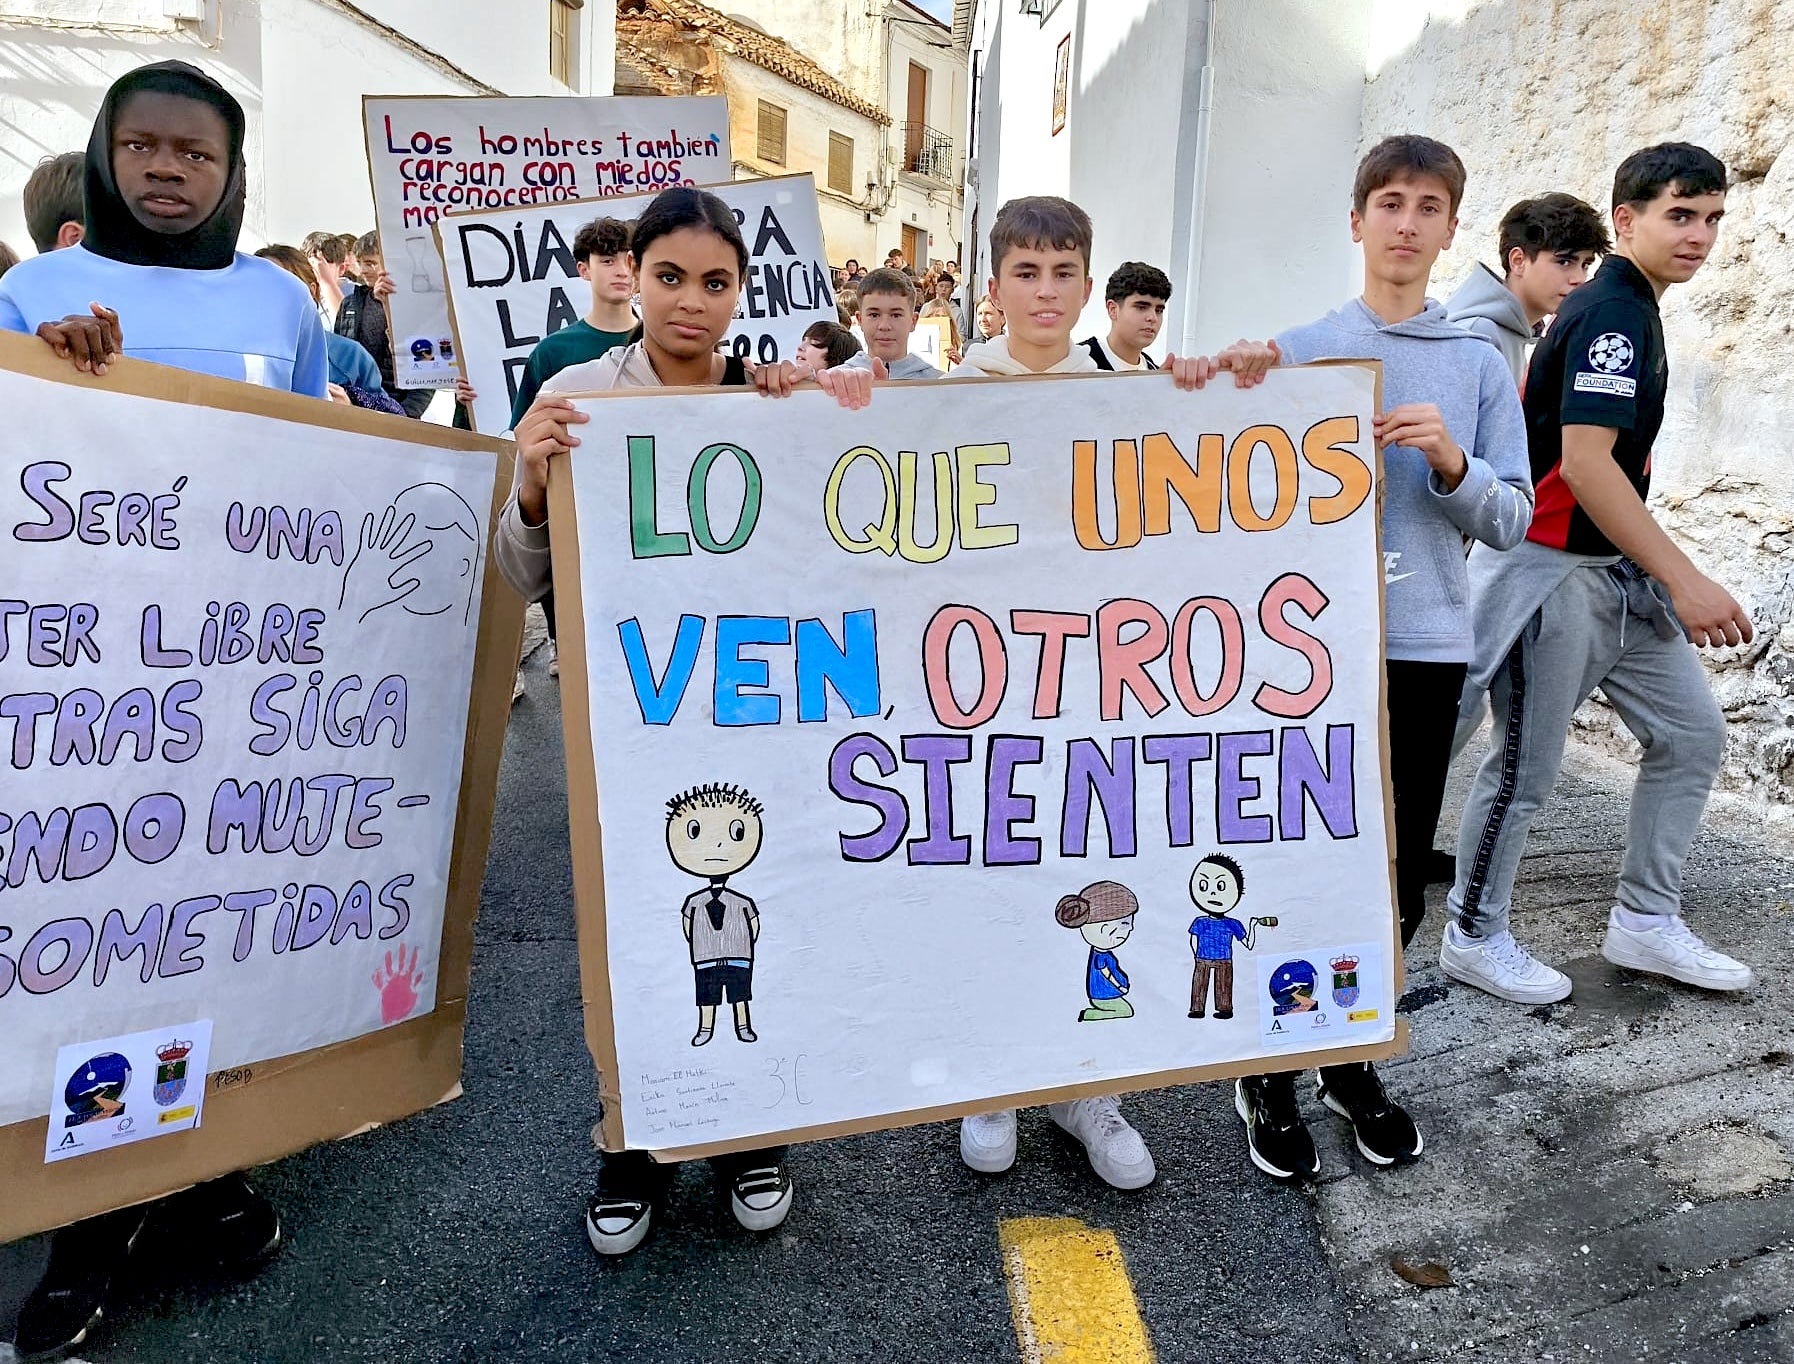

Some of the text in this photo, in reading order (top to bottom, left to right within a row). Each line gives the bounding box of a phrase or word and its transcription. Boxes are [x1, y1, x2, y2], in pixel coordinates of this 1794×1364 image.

[384, 115, 453, 155] Los
[479, 125, 603, 157] hombres
[400, 158, 681, 187] cargan con miedos
[403, 181, 581, 209] reconocerlos
[458, 219, 581, 289] DÍA
[495, 286, 579, 349] LA
[1576, 378, 1636, 392] FOUNDATION
[626, 416, 1373, 564] LO QUE UNOS
[226, 502, 345, 566] UNA
[616, 572, 1333, 729] VEN, OTROS
[0, 679, 203, 770] TRAS
[826, 723, 1360, 867] SIENTEN
